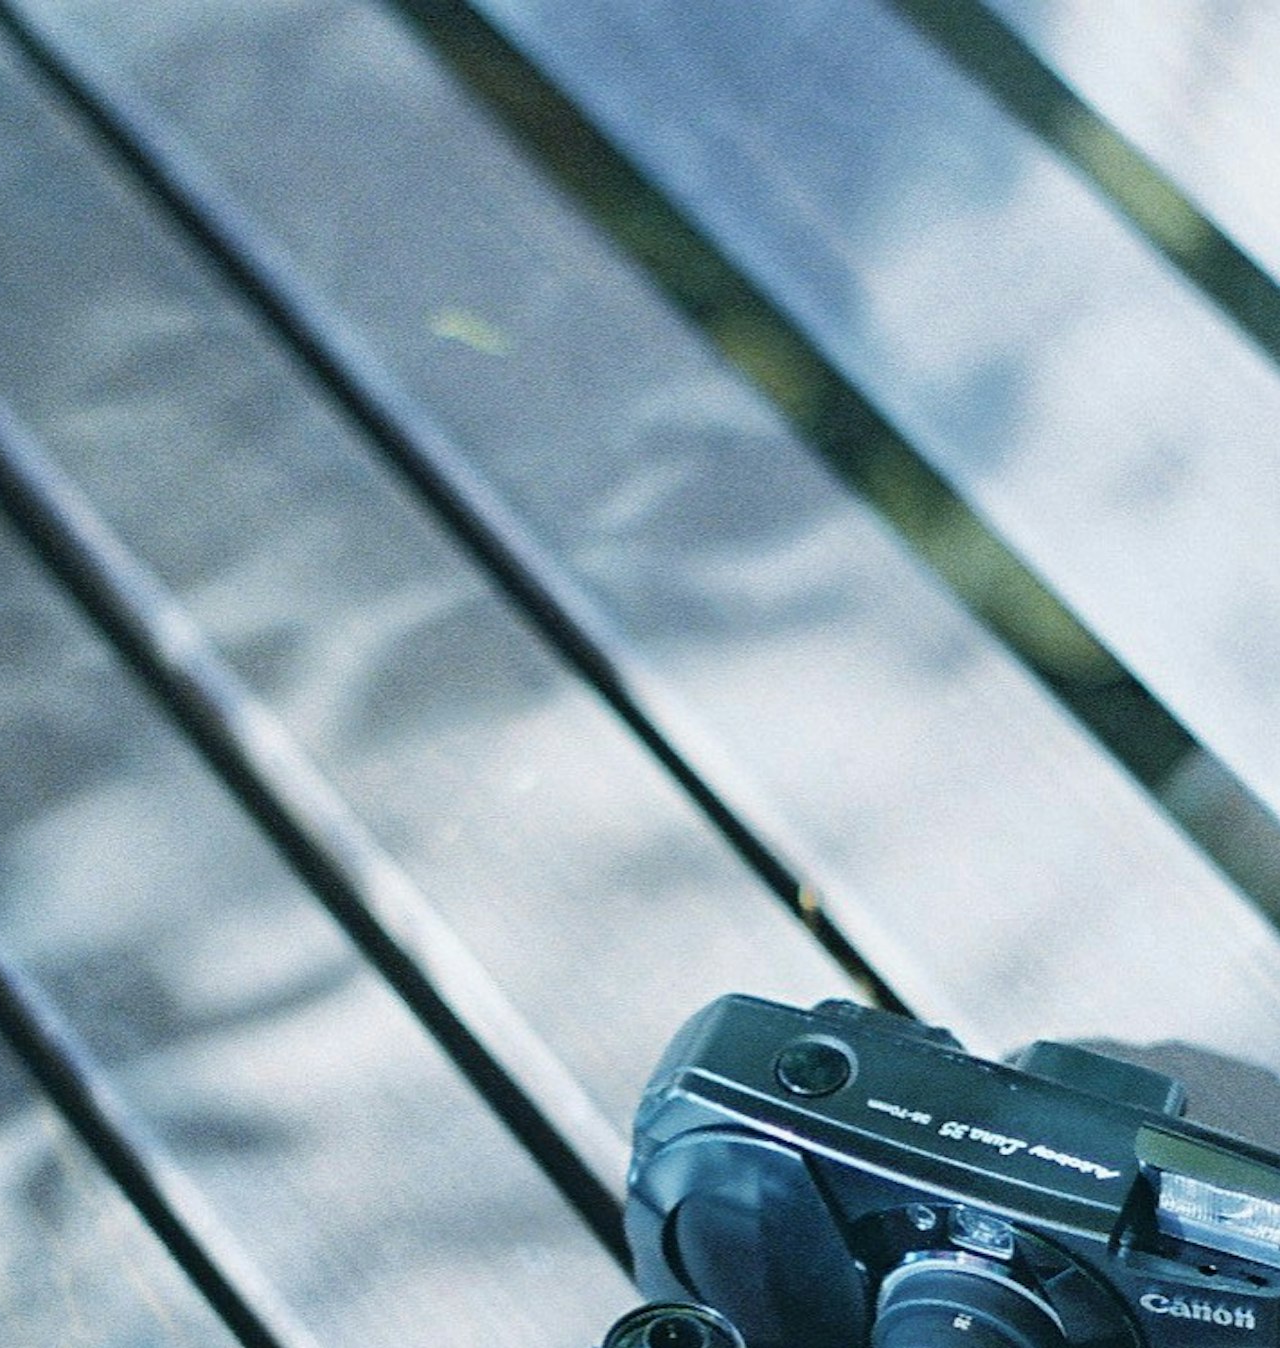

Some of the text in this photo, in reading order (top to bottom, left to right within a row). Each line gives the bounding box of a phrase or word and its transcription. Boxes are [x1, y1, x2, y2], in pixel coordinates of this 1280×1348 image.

[938, 1121, 969, 1140] 35
[969, 1127, 1028, 1156] Luna
[1139, 1293, 1256, 1330] Canon
